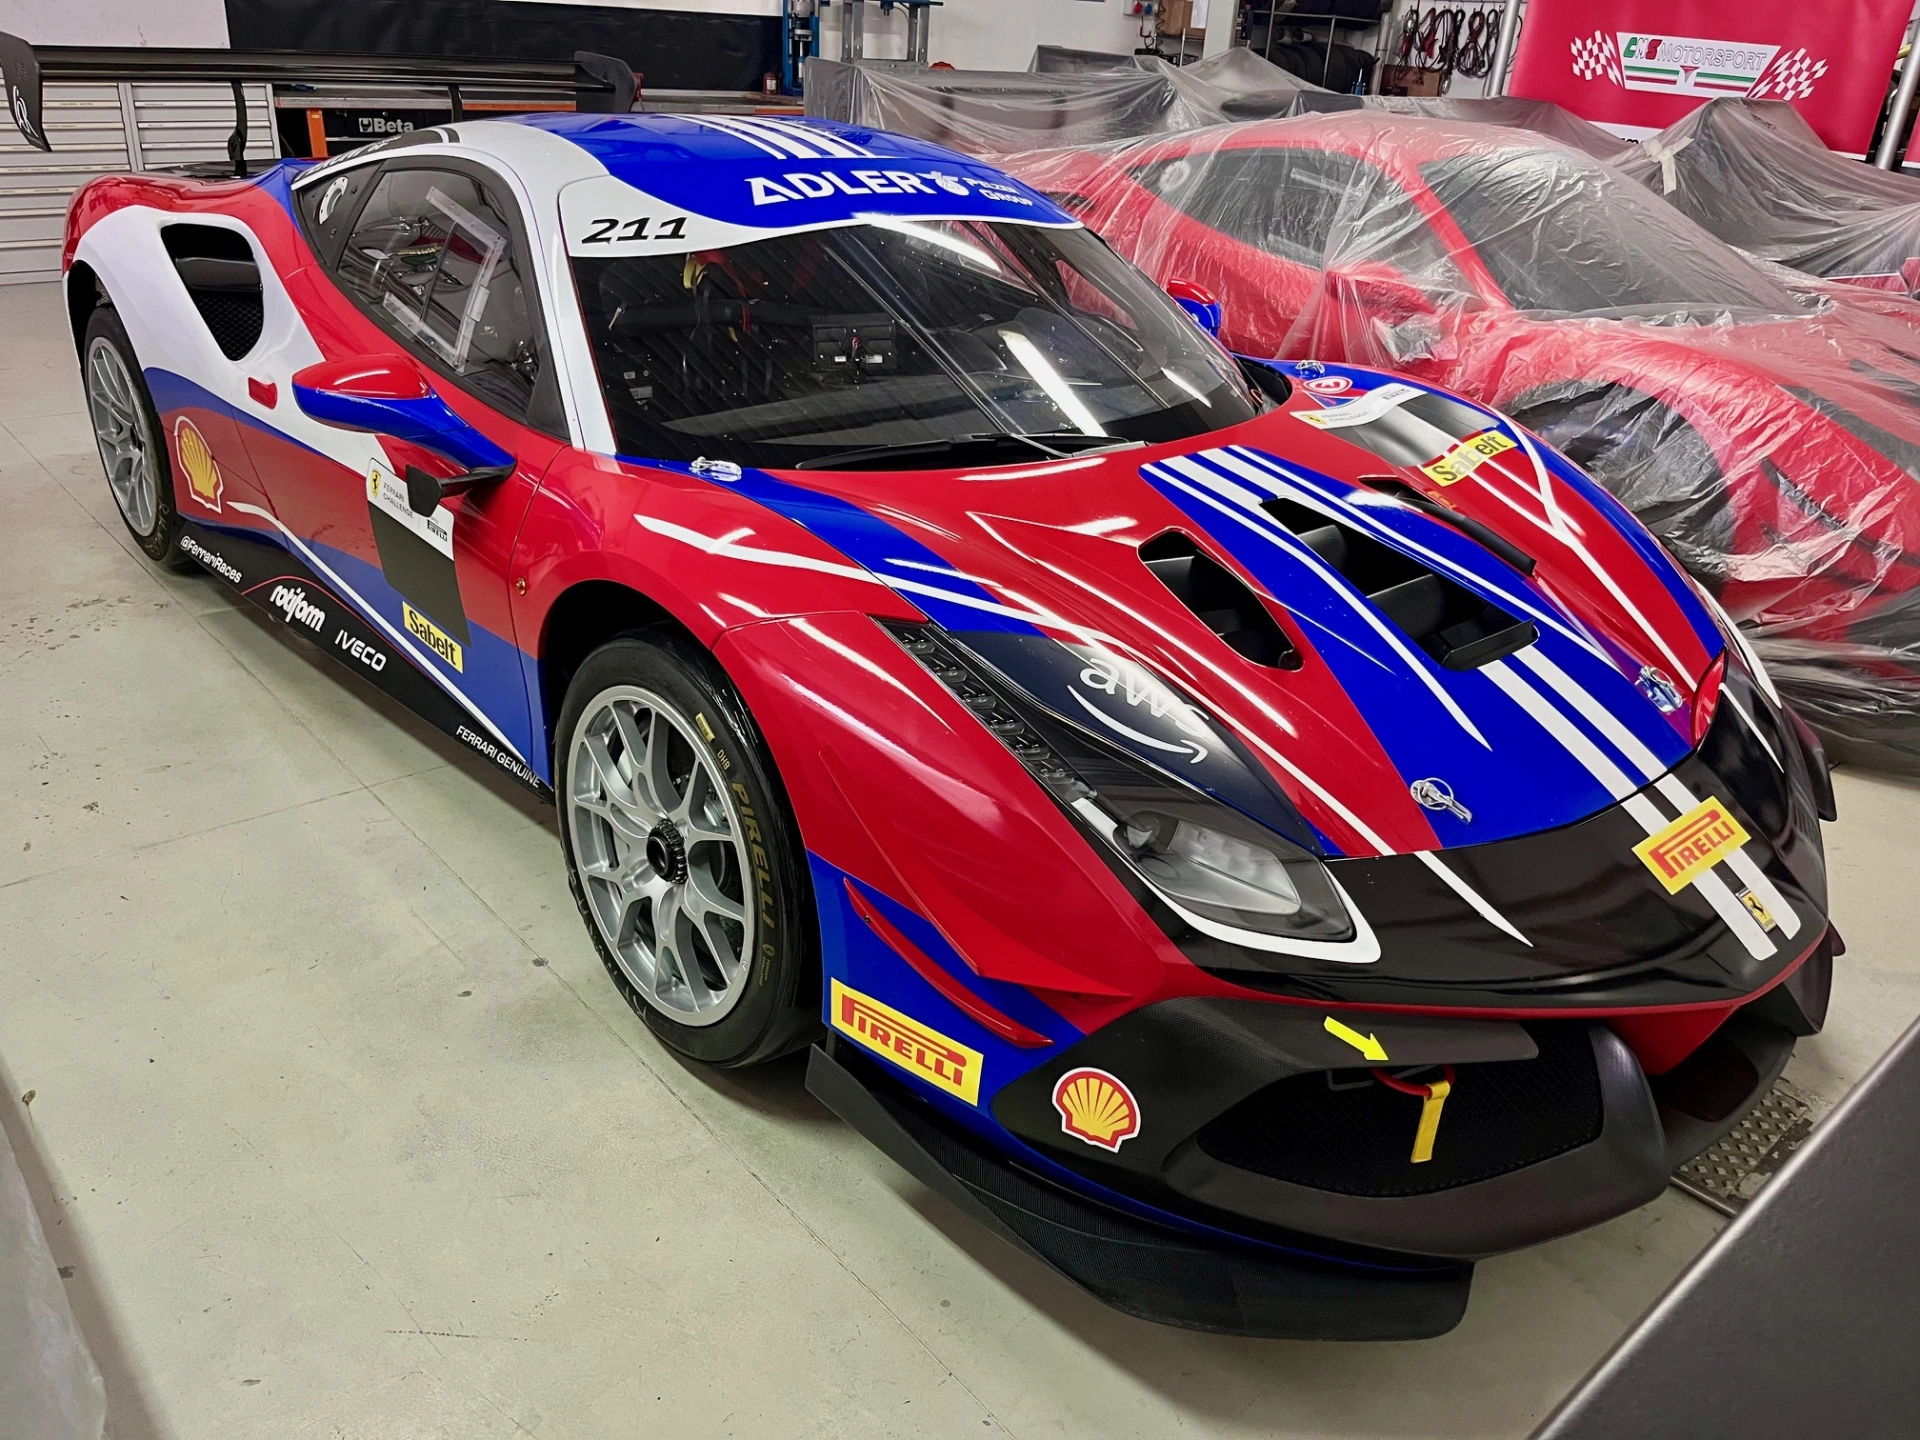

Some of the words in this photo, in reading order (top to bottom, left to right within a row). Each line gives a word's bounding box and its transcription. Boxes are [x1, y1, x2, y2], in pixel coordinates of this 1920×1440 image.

[1623, 36, 1663, 60] CMS
[1656, 42, 1767, 72] MOTORSPORT
[374, 119, 414, 133] Beta
[744, 170, 937, 206] ADLER
[581, 217, 688, 244] 211
[1431, 433, 1508, 483] Sabelt
[382, 493, 414, 519] CHALLENGE
[383, 482, 405, 502] FERRARI
[426, 519, 448, 542] PIRELLI
[180, 535, 243, 583] @FerrariRaces
[269, 584, 326, 632] rotiform
[334, 629, 387, 672] IVECO
[408, 609, 457, 666] Sabelt
[1079, 657, 1210, 737] aws
[455, 725, 498, 759] FERRARI
[496, 752, 541, 789] GENUINE
[731, 782, 776, 929] PIRELLI
[1647, 808, 1736, 880] PIRELLI
[841, 993, 967, 1087] PIRELLI
